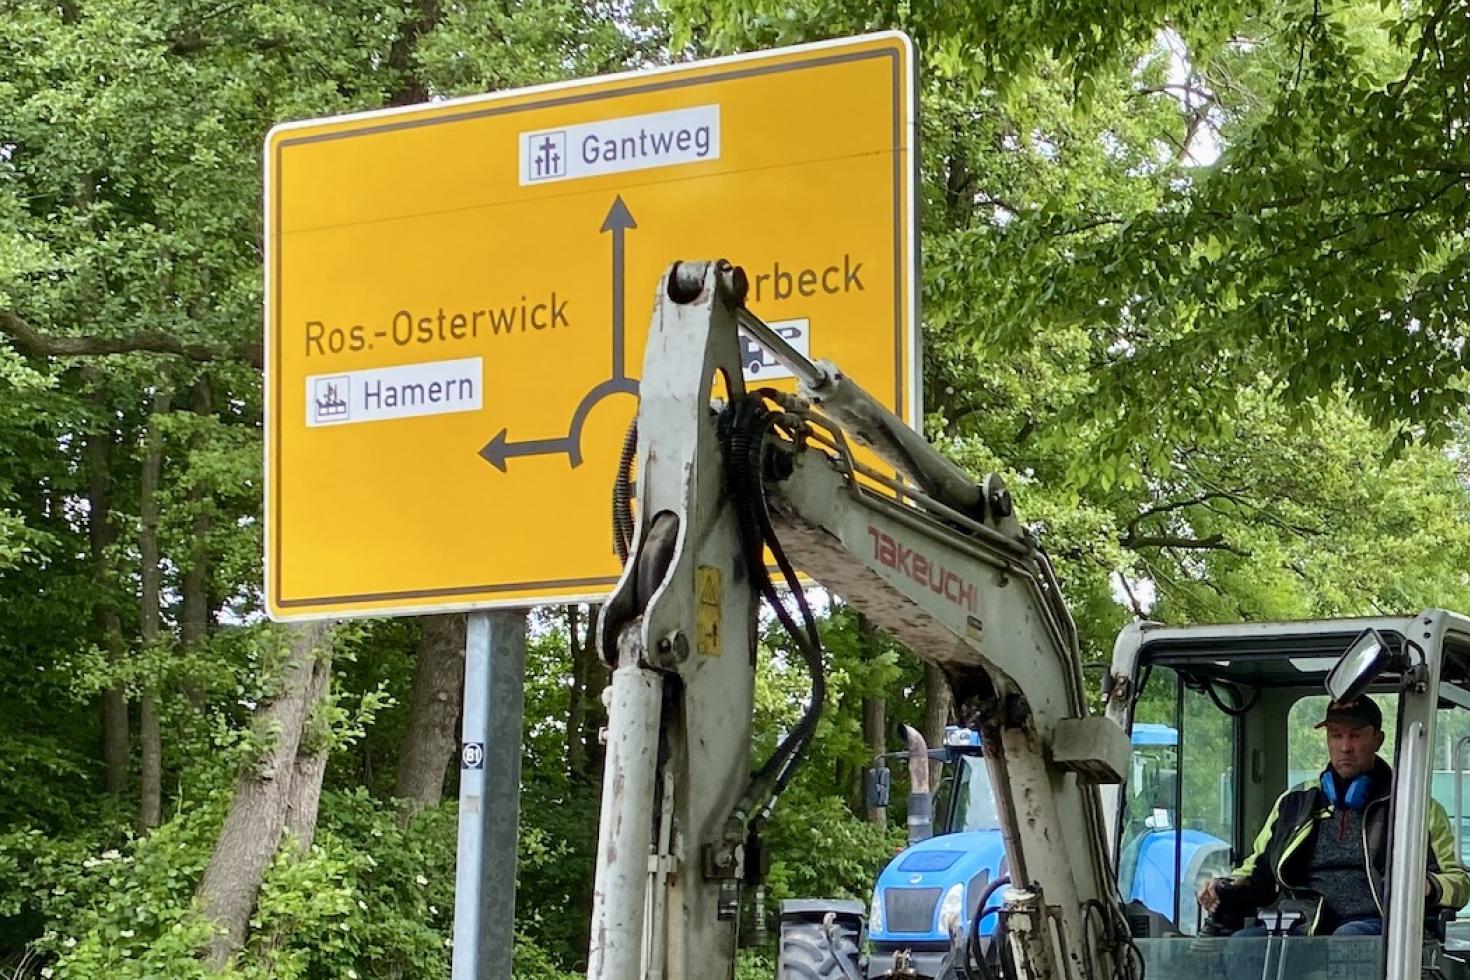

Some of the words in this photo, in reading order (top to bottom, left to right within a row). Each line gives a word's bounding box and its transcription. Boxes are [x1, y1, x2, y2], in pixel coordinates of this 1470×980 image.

[581, 124, 710, 165] Gantweg
[746, 253, 865, 302] rbeck
[304, 291, 570, 357] Ros.-Osterwick
[364, 376, 473, 411] Hamern
